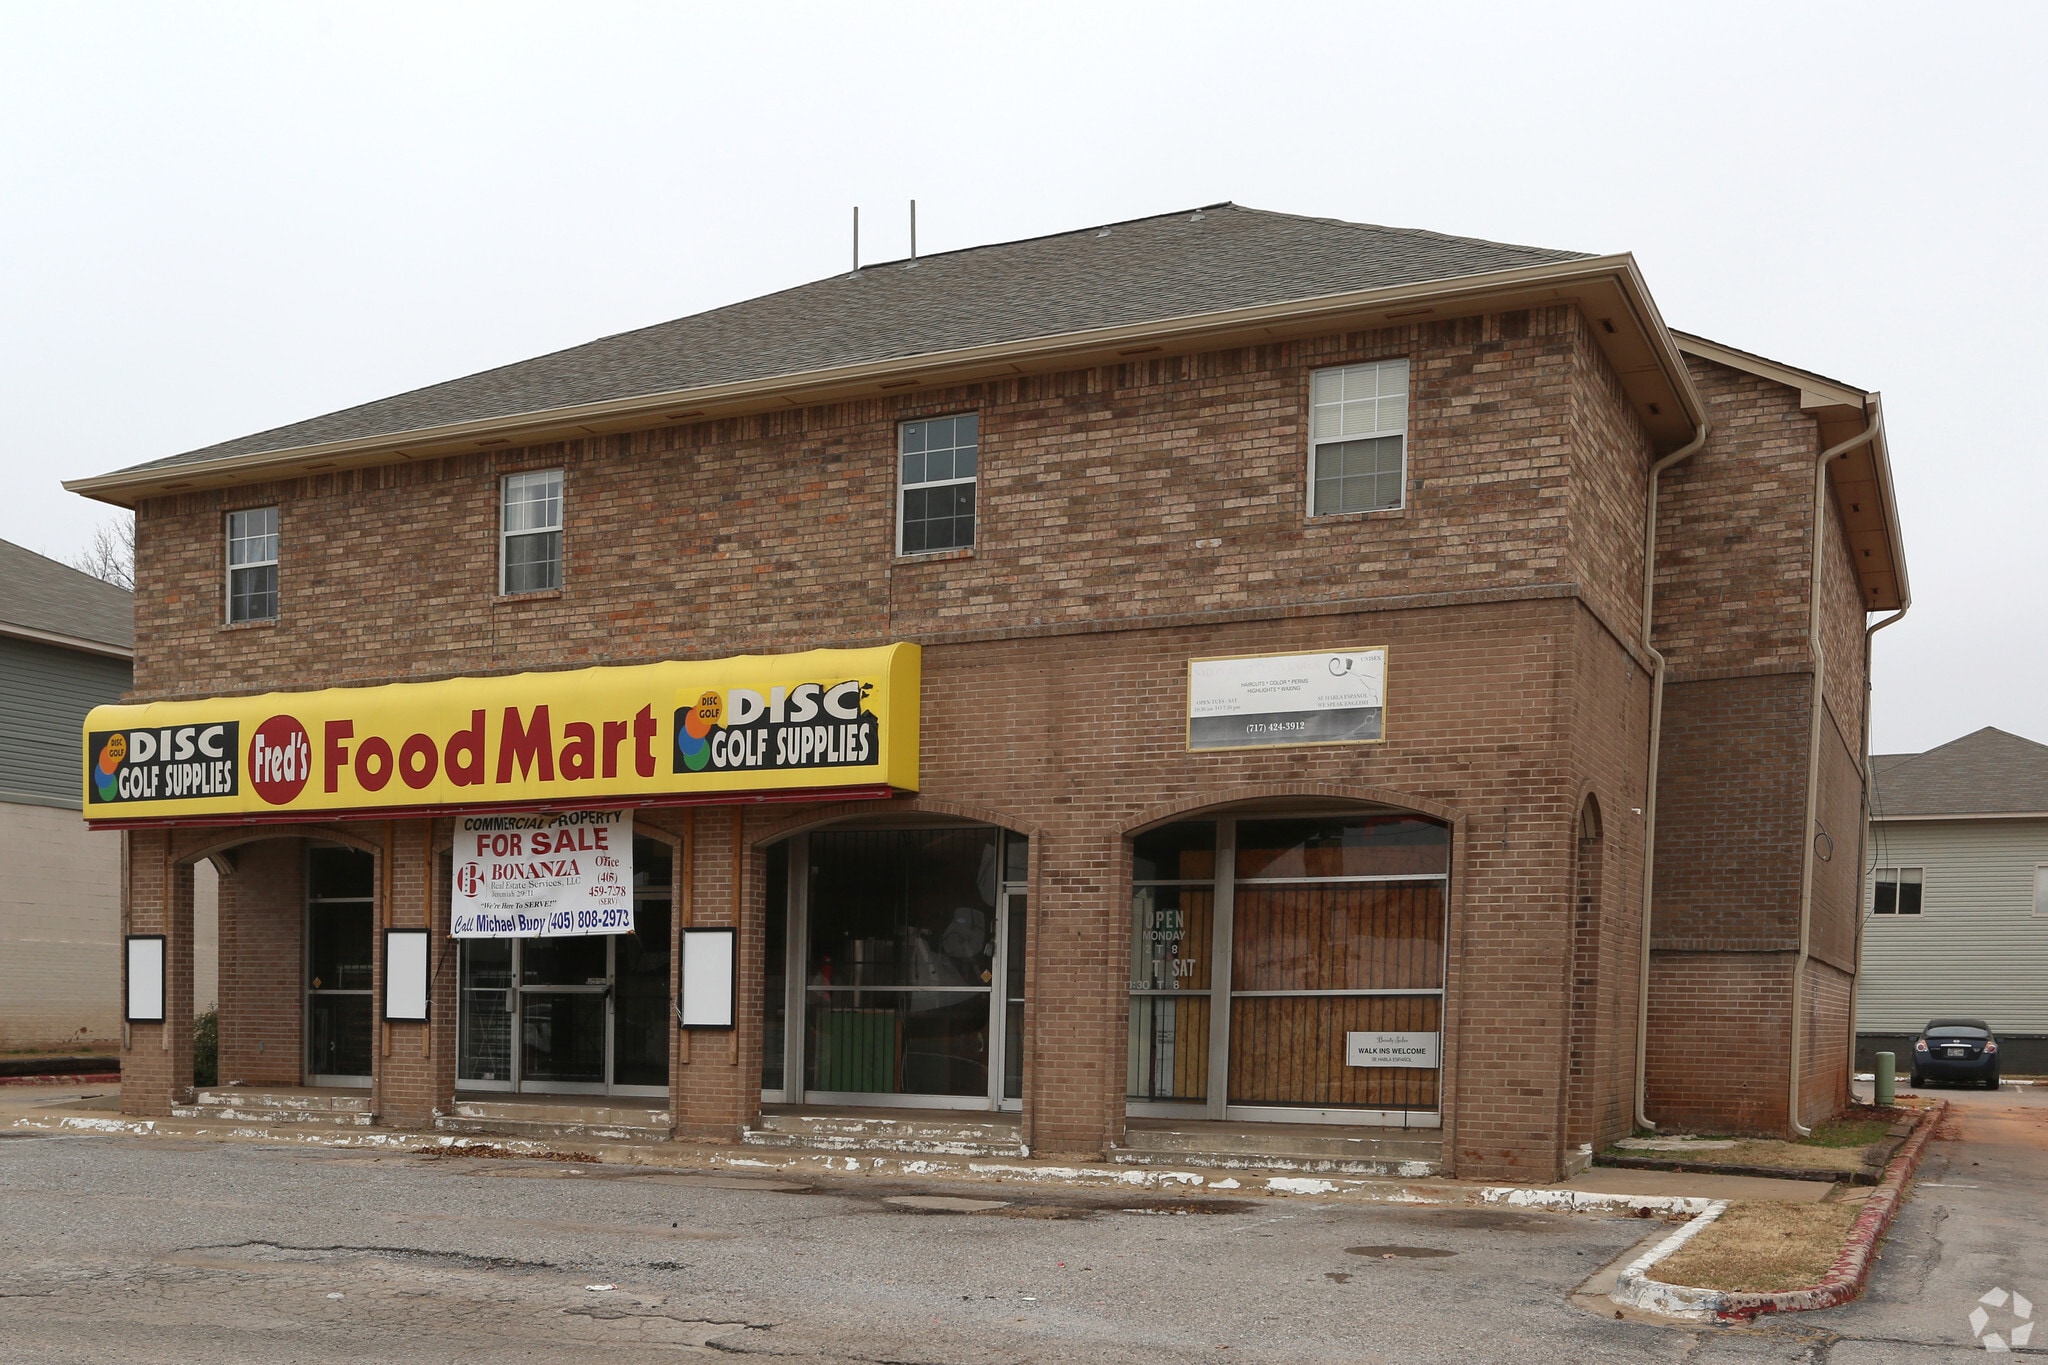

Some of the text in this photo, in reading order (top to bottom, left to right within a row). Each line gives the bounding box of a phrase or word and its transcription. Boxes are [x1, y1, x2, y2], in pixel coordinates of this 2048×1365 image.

[701, 695, 718, 707] DISC
[728, 680, 862, 726] DISC
[699, 707, 720, 720] GOLF
[1246, 721, 1305, 733] (717) 424-3912
[110, 737, 124, 747] DISC
[129, 725, 224, 764] DISC
[324, 703, 657, 793] Food Mart
[712, 722, 870, 768] GOLF SUPPLIES
[108, 747, 125, 758] GOLF
[255, 731, 308, 784] Fred's
[119, 760, 232, 800] GOLF SUPPLIES
[464, 810, 623, 832] COMMERCIAL PROPERTY
[477, 827, 609, 857] FOR SALE
[492, 859, 581, 881] BONANZA
[491, 881, 505, 890] Real
[506, 880, 527, 889] Estate
[567, 877, 581, 886] LLC
[597, 872, 618, 884] (405)
[491, 889, 534, 898] Jeremiah 29:11
[598, 897, 618, 905] (SERV)
[454, 915, 474, 934] Call
[476, 914, 516, 932] Michael
[547, 911, 575, 933] (405)
[578, 909, 630, 929] 808-2973
[1145, 910, 1184, 929] OPEN
[1143, 930, 1186, 941] MONDAY
[1171, 945, 1178, 954] 8
[1152, 959, 1196, 977] T SAT
[1173, 980, 1180, 989] 8
